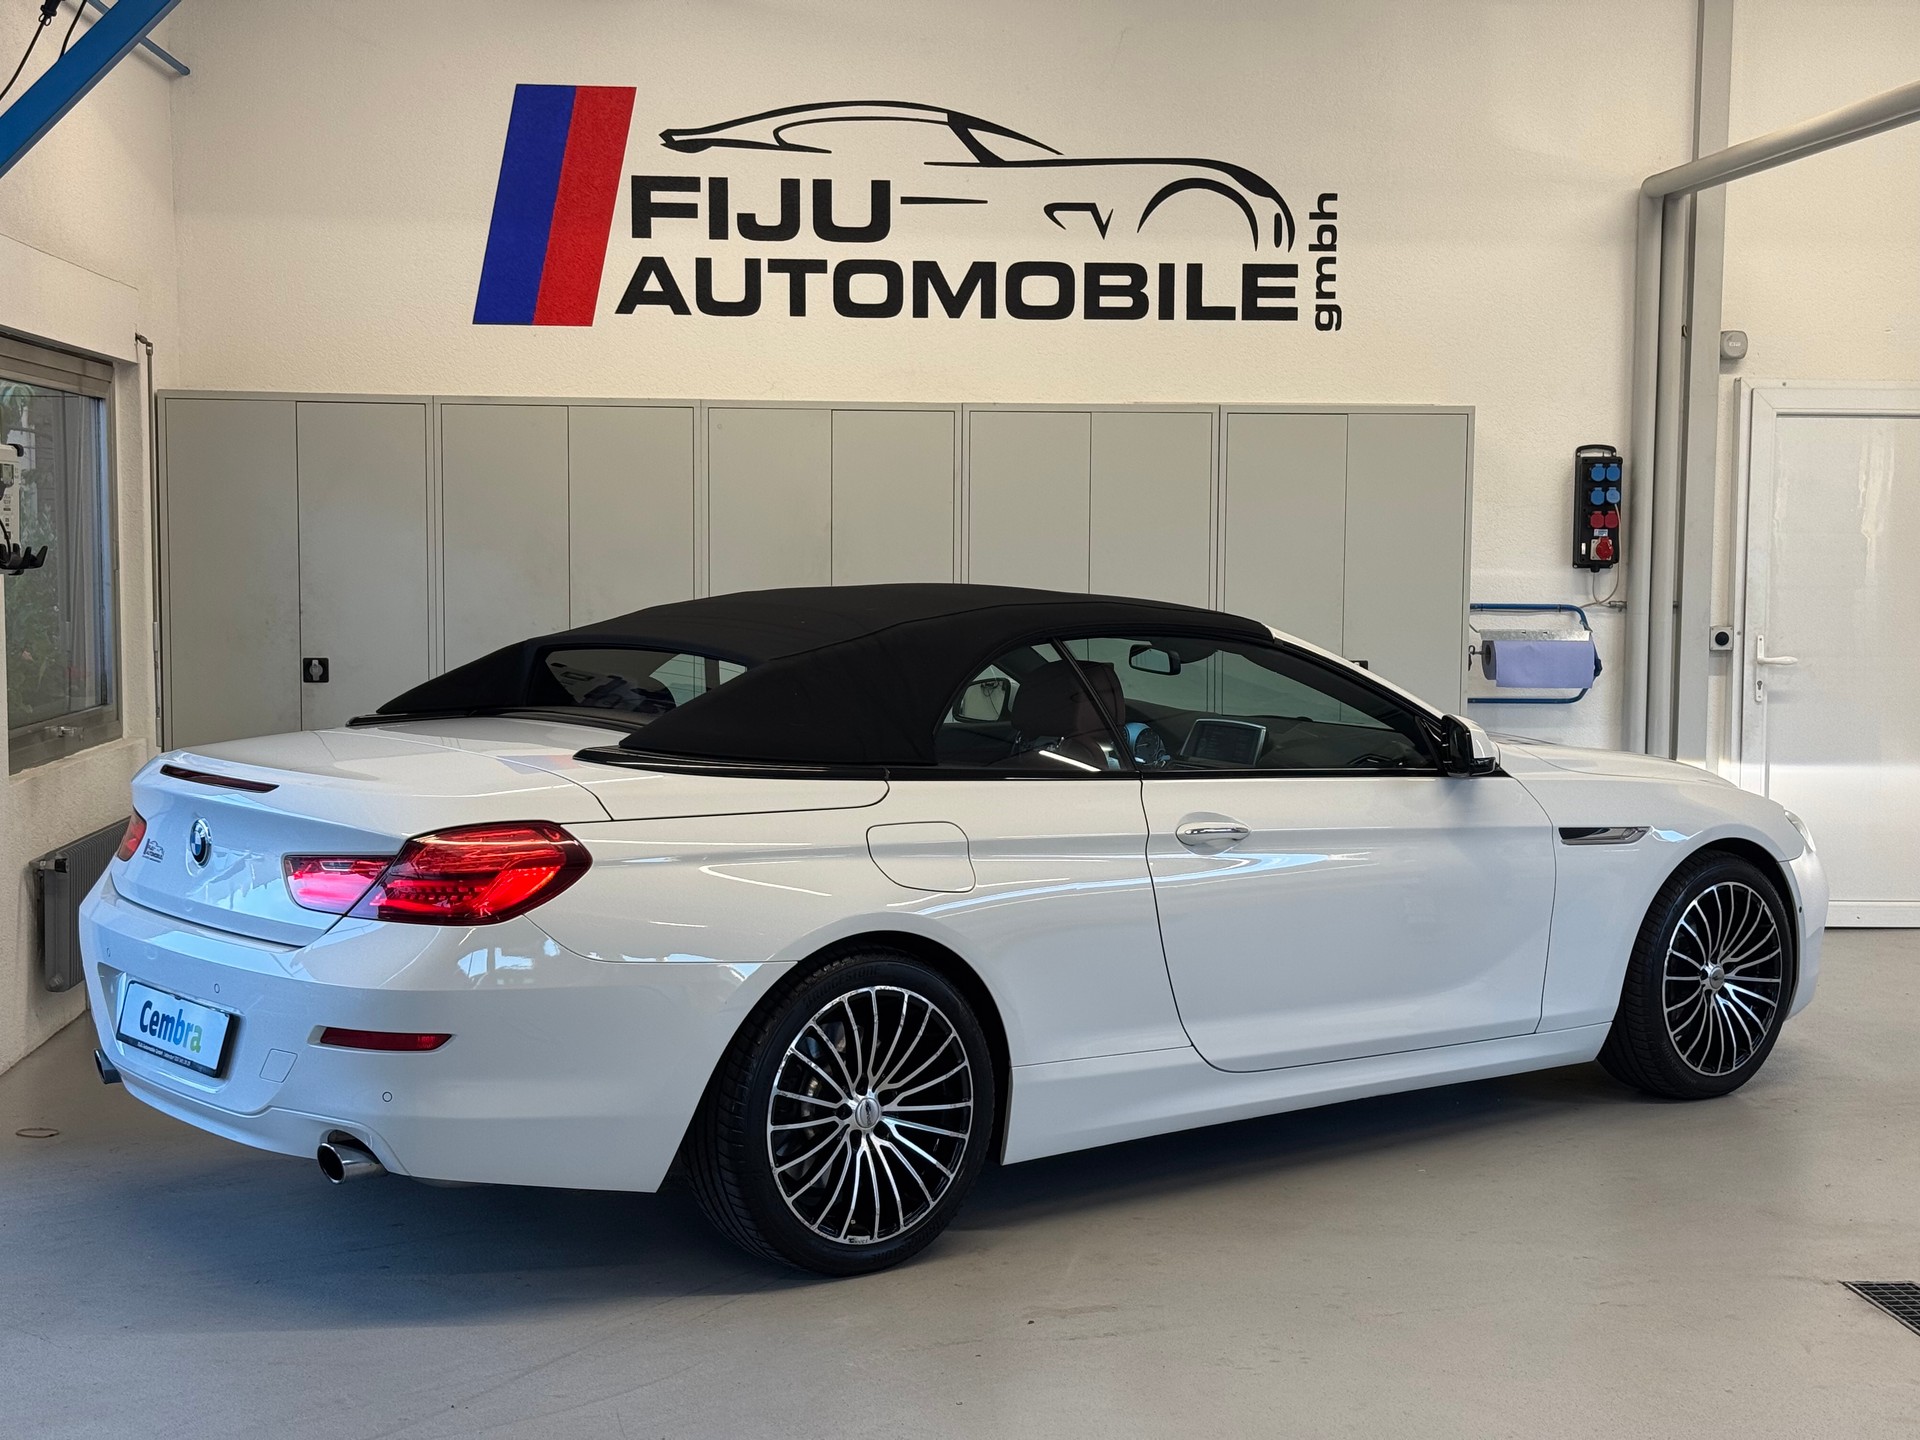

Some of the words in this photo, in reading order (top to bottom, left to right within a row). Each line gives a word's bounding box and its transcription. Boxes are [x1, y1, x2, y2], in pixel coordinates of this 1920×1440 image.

[631, 174, 891, 243] FIJU
[614, 256, 1299, 321] AUTOMOBILE
[1308, 192, 1342, 332] gmbh
[139, 999, 203, 1053] Cembra
